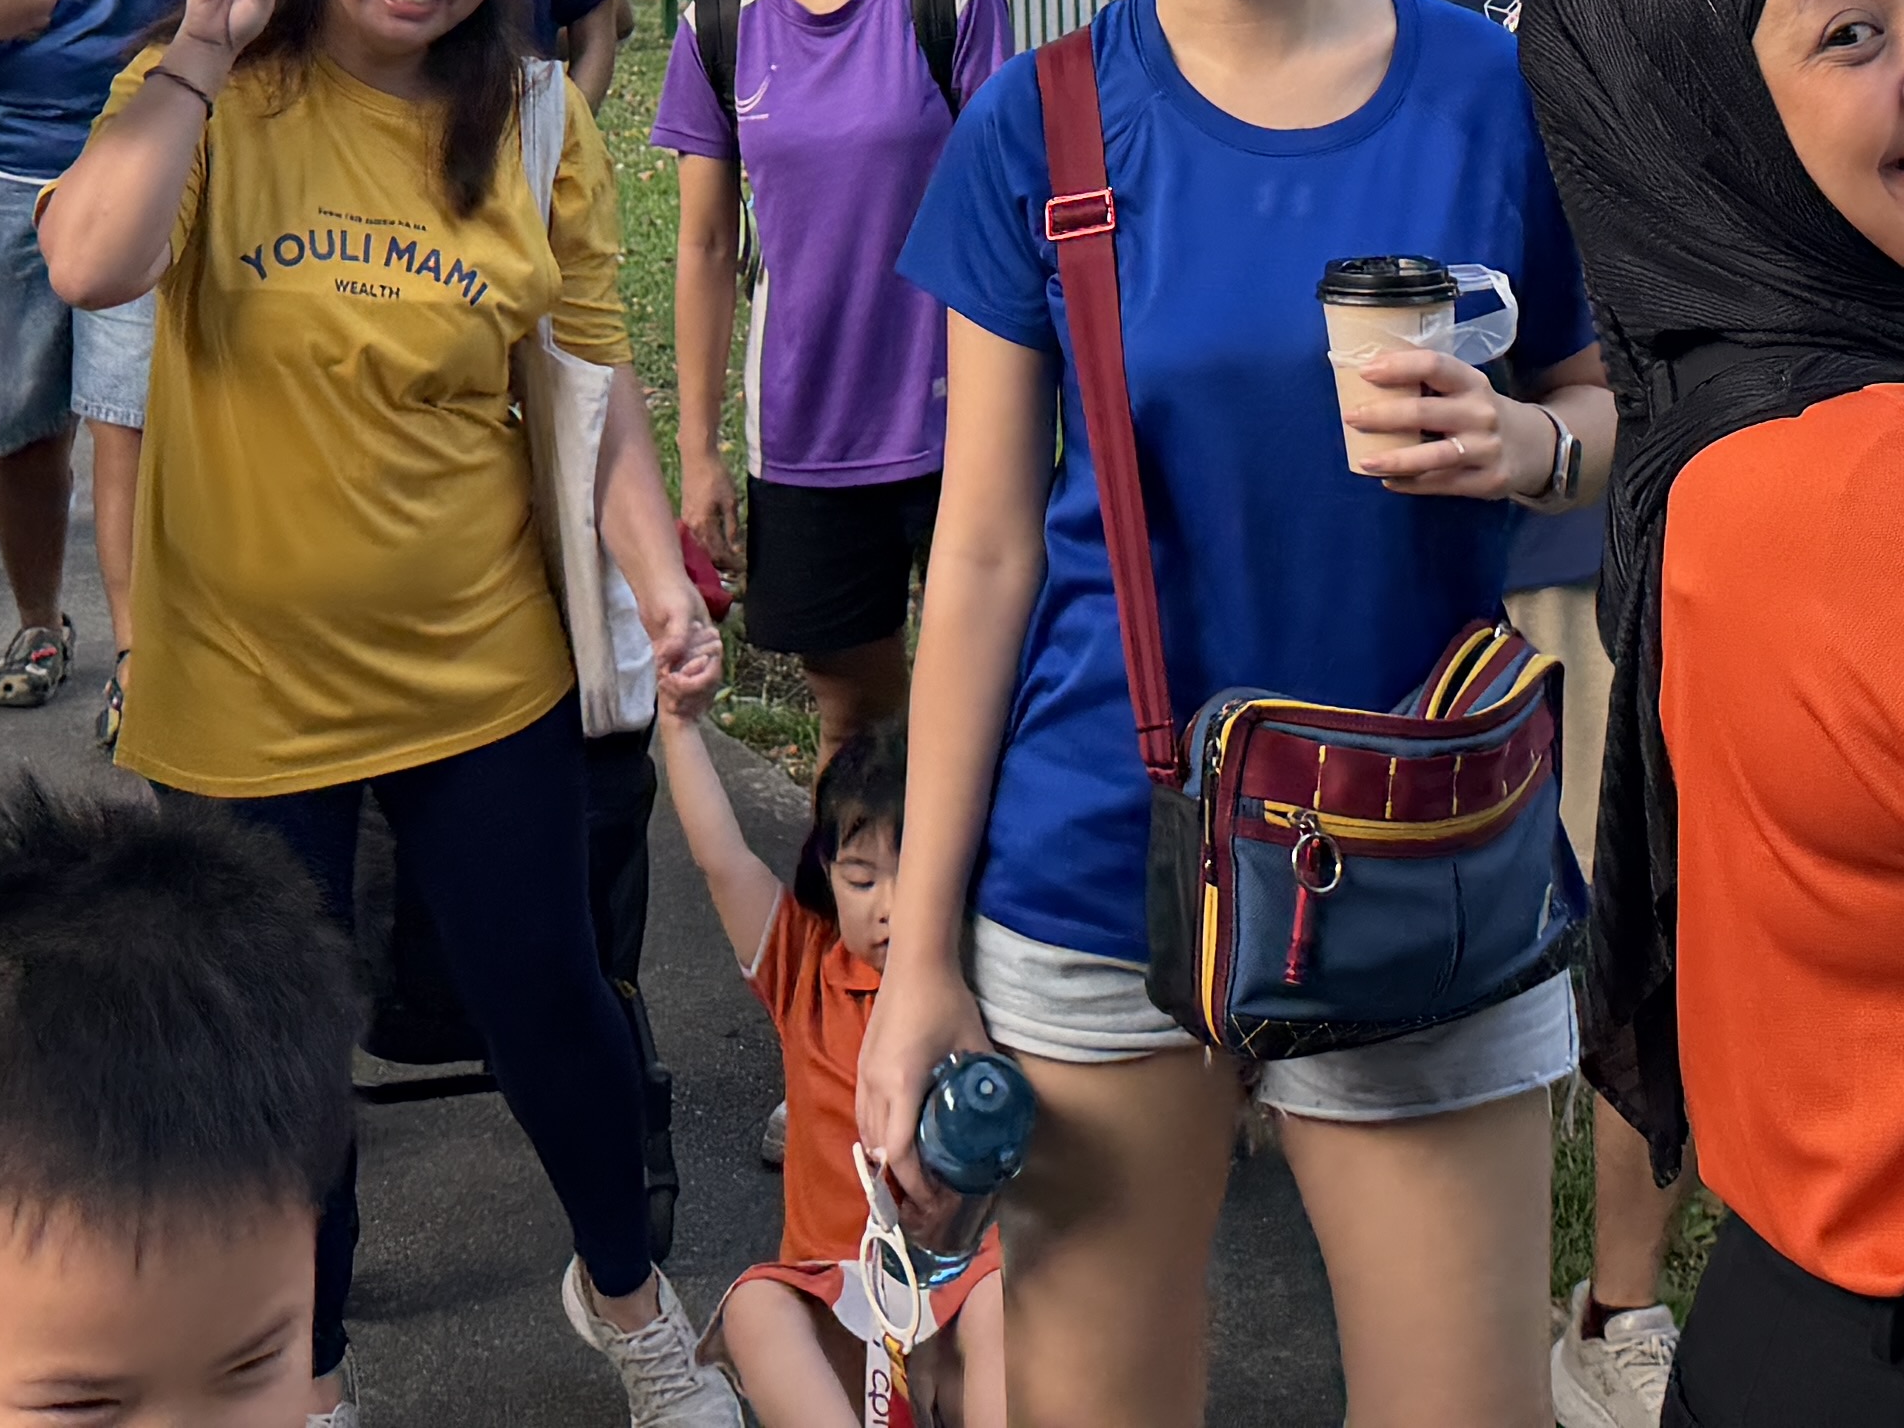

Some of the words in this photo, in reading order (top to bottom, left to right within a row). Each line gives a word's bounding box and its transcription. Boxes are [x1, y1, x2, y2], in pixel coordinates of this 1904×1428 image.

[239, 228, 372, 282] YOULI
[383, 235, 490, 308] MAMI
[334, 277, 401, 300] WEALTH
